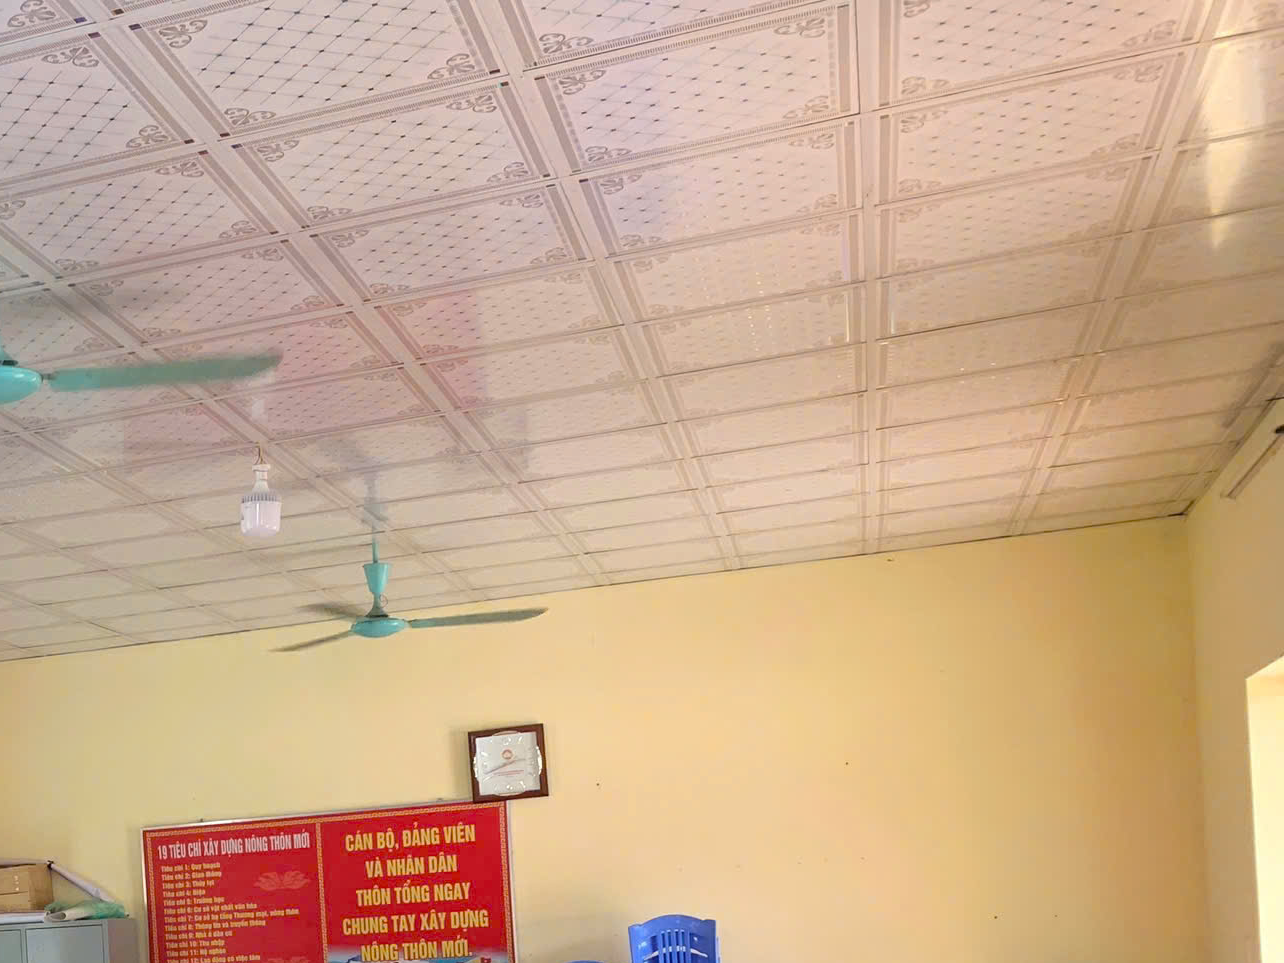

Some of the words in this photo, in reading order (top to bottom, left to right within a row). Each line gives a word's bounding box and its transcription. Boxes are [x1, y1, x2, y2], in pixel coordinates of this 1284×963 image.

[157, 845, 168, 860] 19
[169, 841, 187, 859] TIÊU
[188, 839, 202, 858] CHÍ
[203, 838, 219, 856] XÂY
[245, 834, 268, 853] NÔNG
[269, 832, 292, 851] THÔN
[293, 828, 310, 849] MỚI
[345, 830, 373, 852] CÁN
[377, 827, 399, 852] BỘ,
[402, 821, 440, 847] ĐẢNG
[443, 822, 476, 844] VIÊN
[365, 857, 383, 878] VÀ
[387, 854, 424, 876] NHÂN
[428, 852, 458, 874] DÂN
[356, 885, 391, 907] THÔN
[433, 882, 471, 902] NGAY
[343, 916, 389, 936] CHUNG
[391, 914, 416, 933] TAY
[420, 909, 446, 931] XÂY
[450, 909, 489, 932] DỰNG
[361, 941, 399, 962] NÔNG
[402, 938, 438, 960] THÔN
[441, 935, 473, 957] MỚI.
